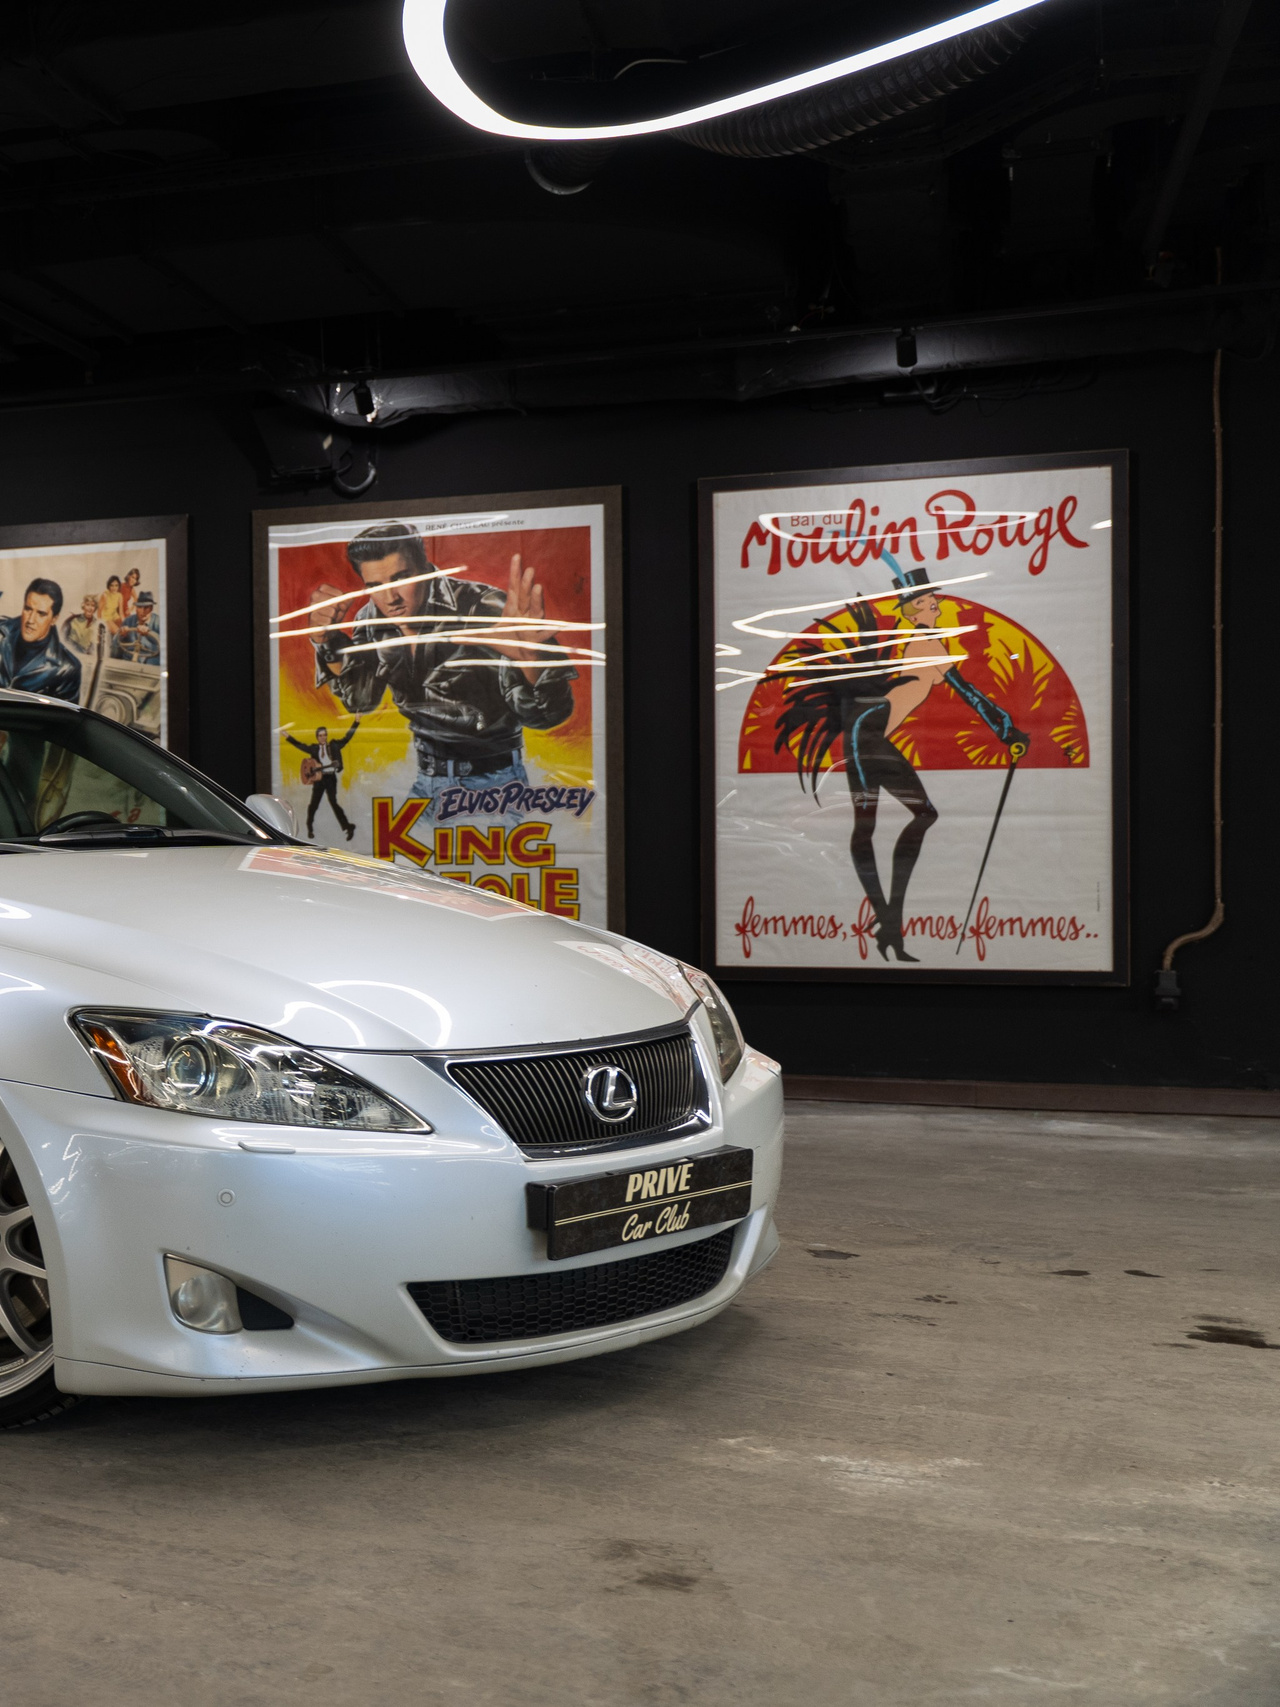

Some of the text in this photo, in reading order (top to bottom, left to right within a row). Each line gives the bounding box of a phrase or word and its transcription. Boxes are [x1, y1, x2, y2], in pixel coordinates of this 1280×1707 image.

[491, 519, 525, 528] présente
[740, 489, 1090, 576] Moulin Rouge
[790, 513, 842, 527] Bal du
[435, 781, 598, 822] ELVIS PRESLEY
[372, 796, 556, 868] KING
[735, 896, 848, 958] femmes,
[850, 896, 965, 960] femes,
[625, 1163, 694, 1202] PRIVE
[622, 1201, 691, 1242] Car Club
